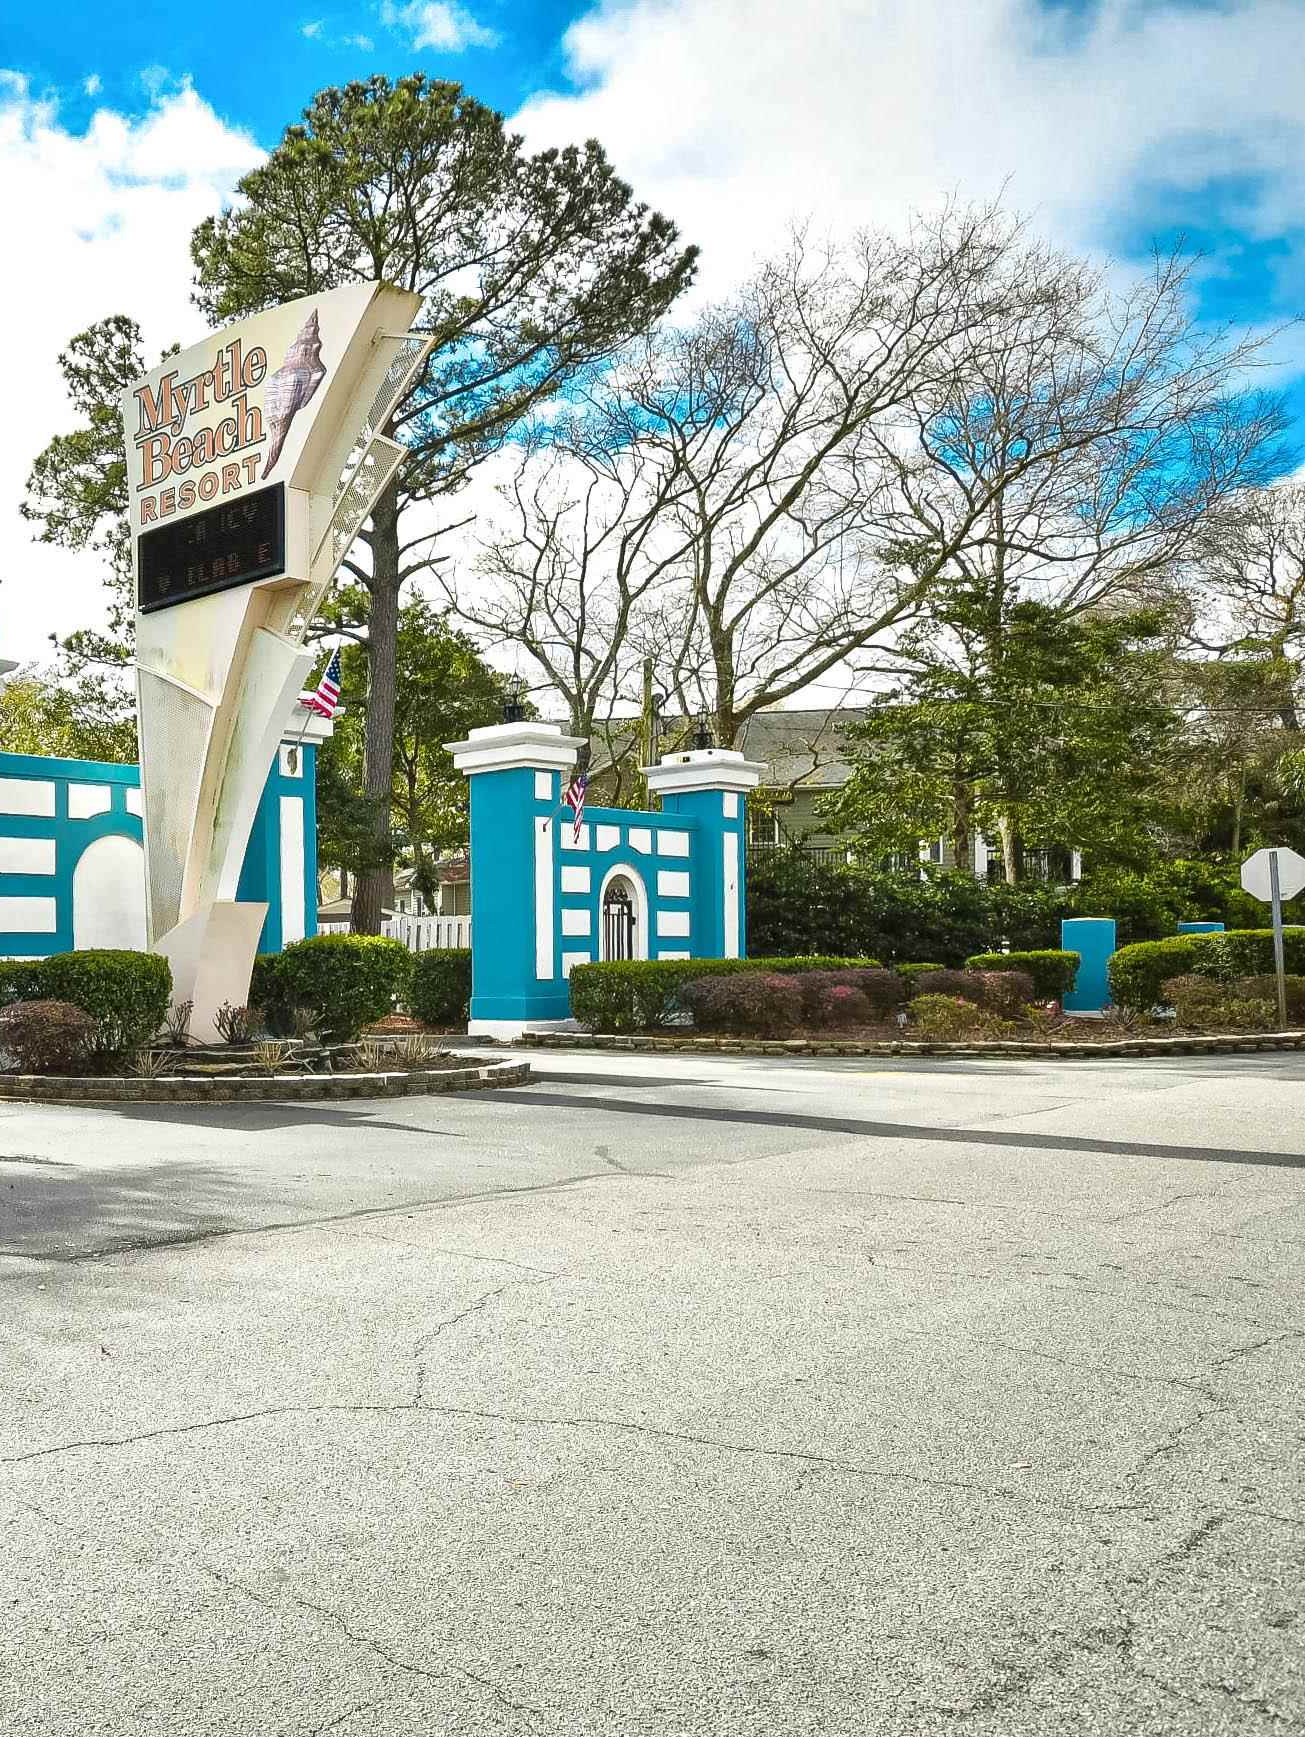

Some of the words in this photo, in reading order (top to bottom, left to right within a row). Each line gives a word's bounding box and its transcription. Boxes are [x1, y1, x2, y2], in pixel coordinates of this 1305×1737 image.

[133, 338, 267, 441] Myrtle
[135, 393, 267, 492] Beach
[141, 453, 262, 525] RESORT
